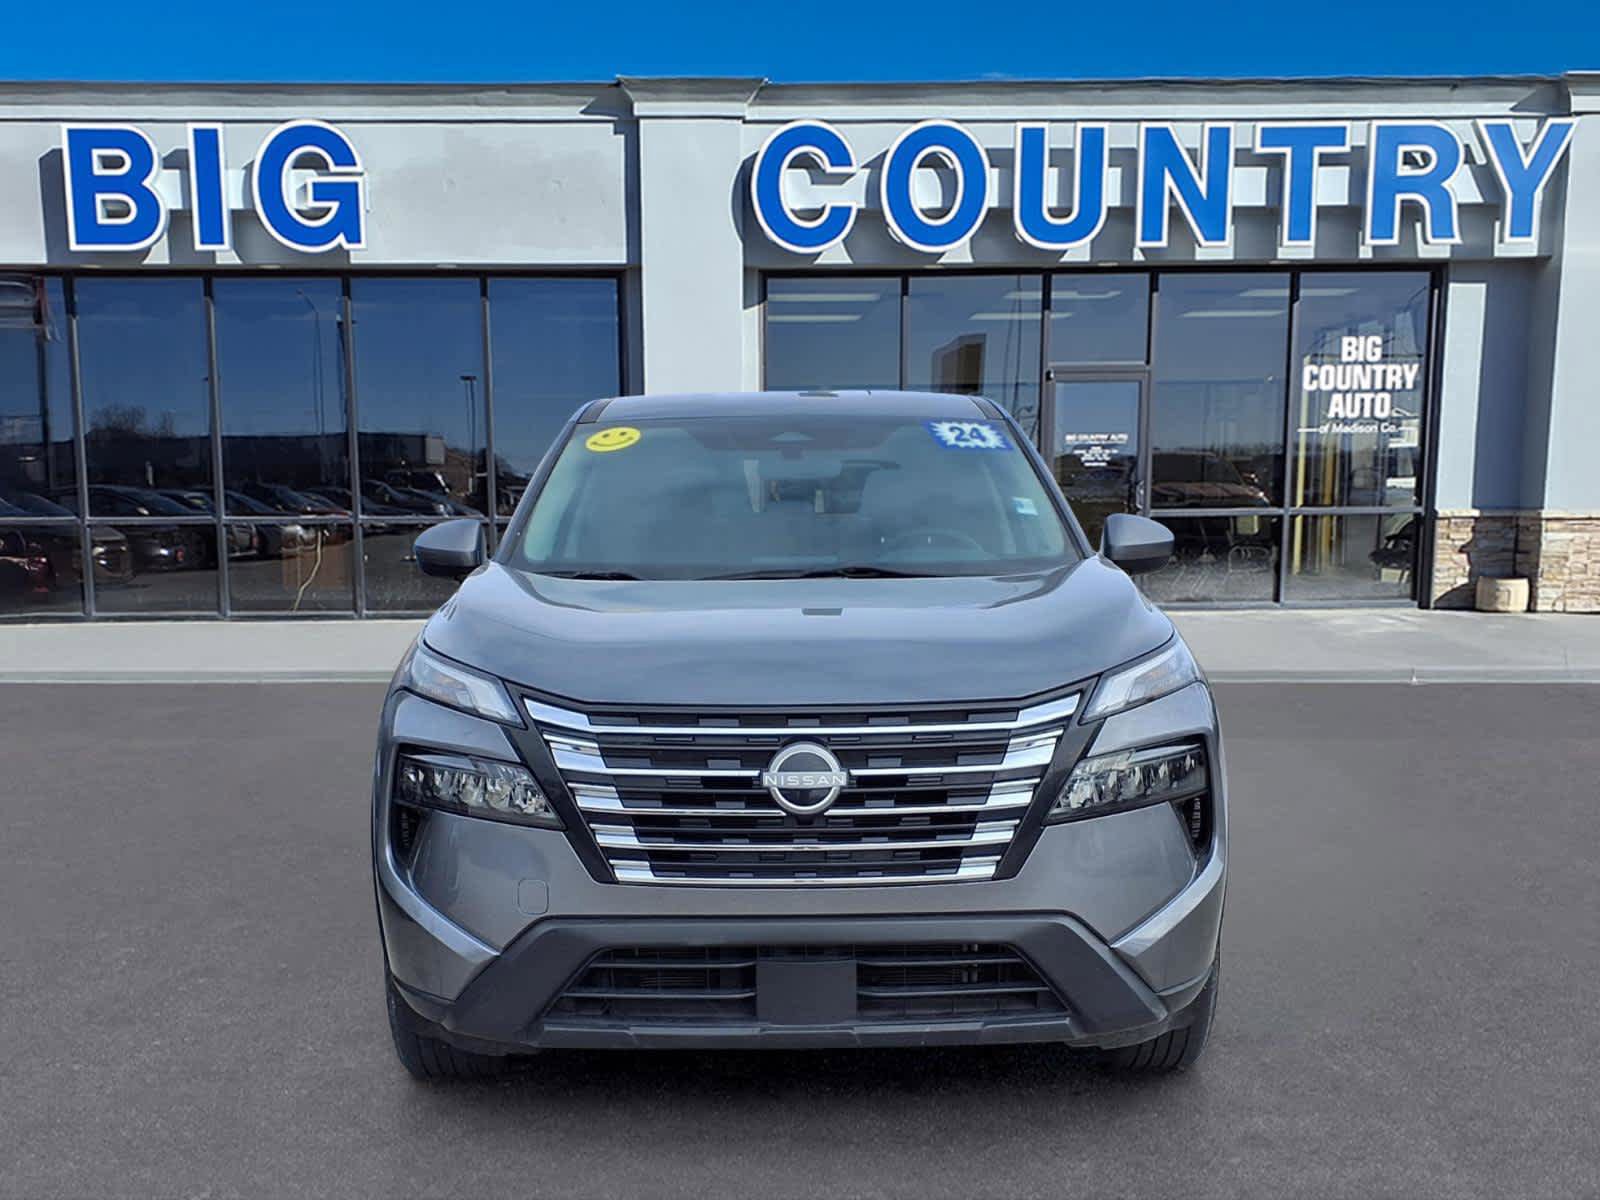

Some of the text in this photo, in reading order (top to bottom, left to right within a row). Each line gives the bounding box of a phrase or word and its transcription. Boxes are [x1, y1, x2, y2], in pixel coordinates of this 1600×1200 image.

[61, 117, 1577, 256] BIG COUNTRY
[1341, 335, 1382, 362] BIG
[1302, 363, 1419, 391] COUNTRY
[1327, 392, 1391, 419] AUTO
[948, 426, 987, 442] 24
[1332, 423, 1378, 433] Madison
[764, 775, 845, 787] NISSAN
